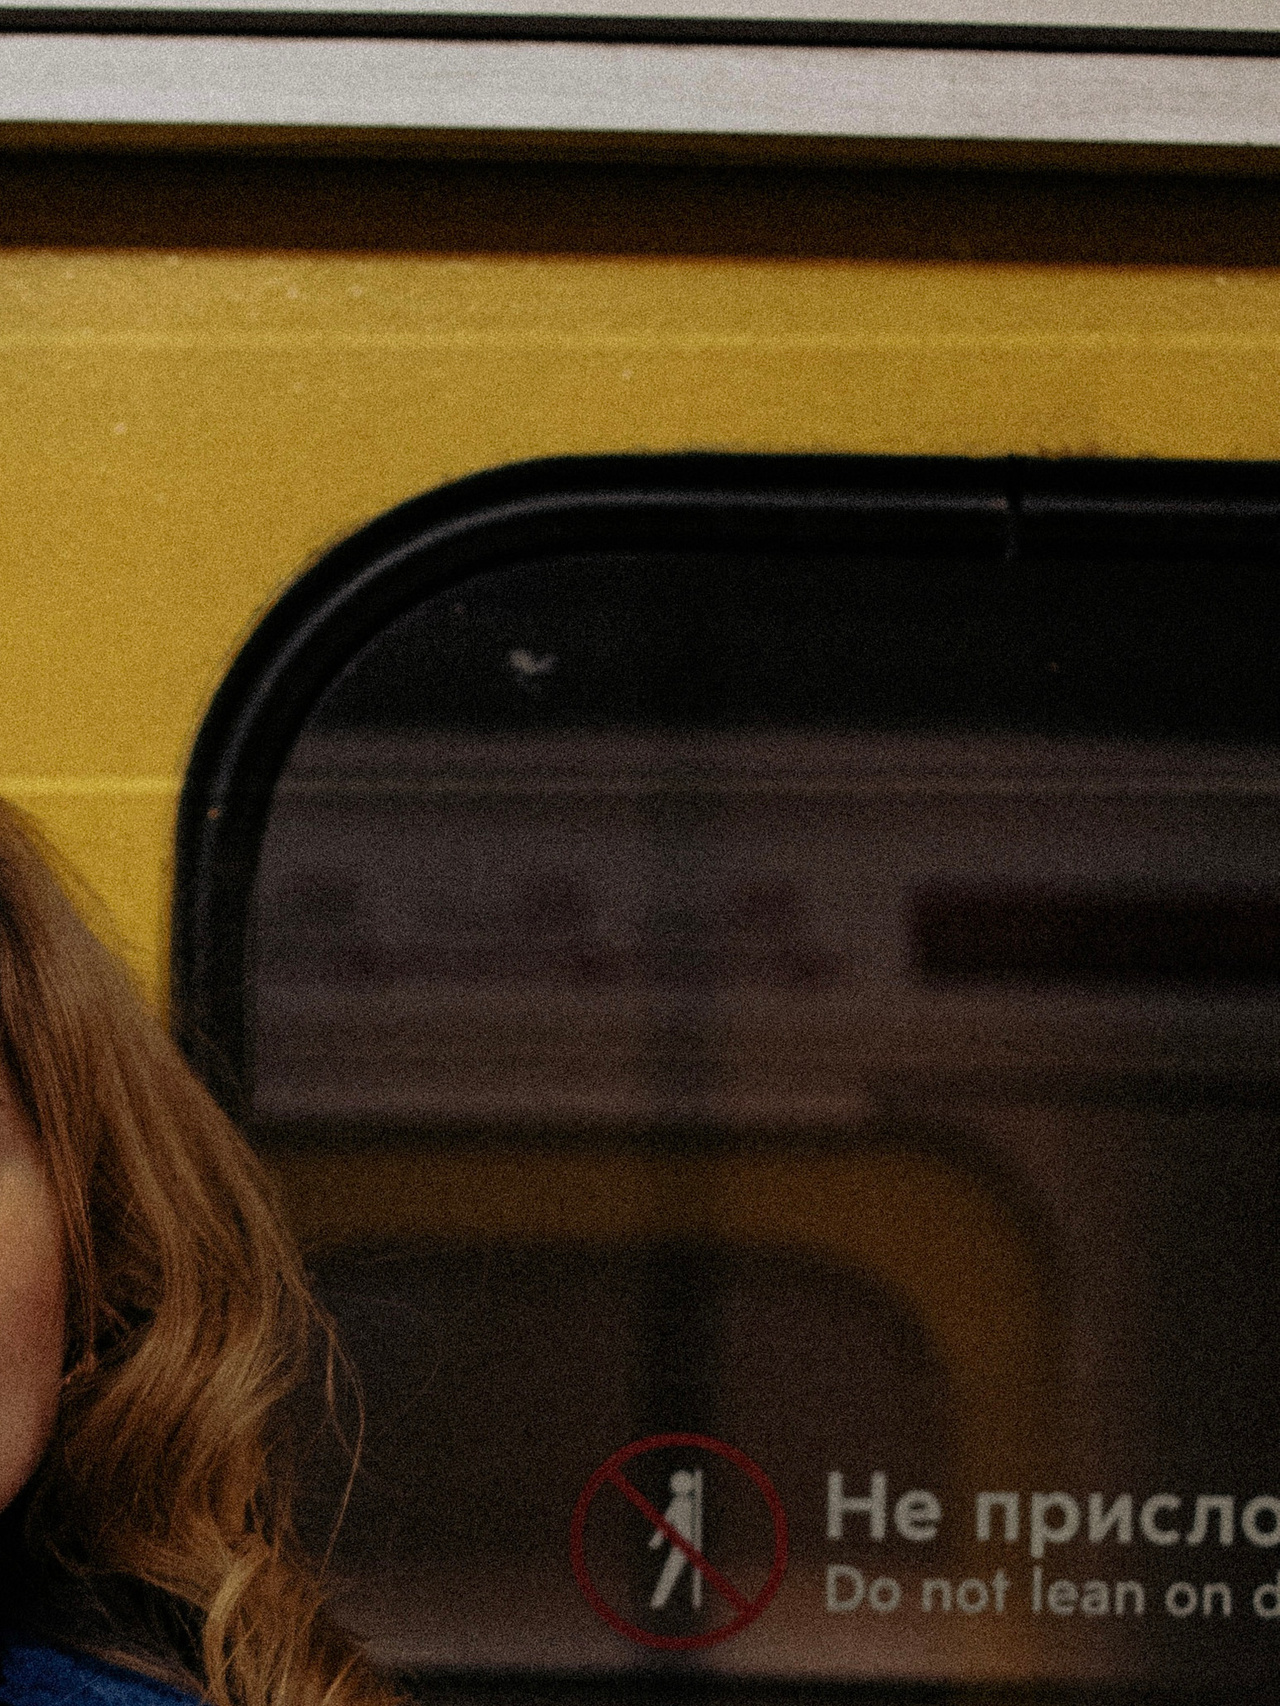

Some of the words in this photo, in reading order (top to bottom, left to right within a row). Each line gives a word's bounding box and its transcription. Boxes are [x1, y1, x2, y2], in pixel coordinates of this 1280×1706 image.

[826, 1470, 943, 1543] Не
[974, 1489, 1280, 1559] присло
[826, 1564, 901, 1614] Do
[921, 1566, 1009, 1615] not
[1032, 1565, 1145, 1617] lean
[1165, 1579, 1233, 1618] on
